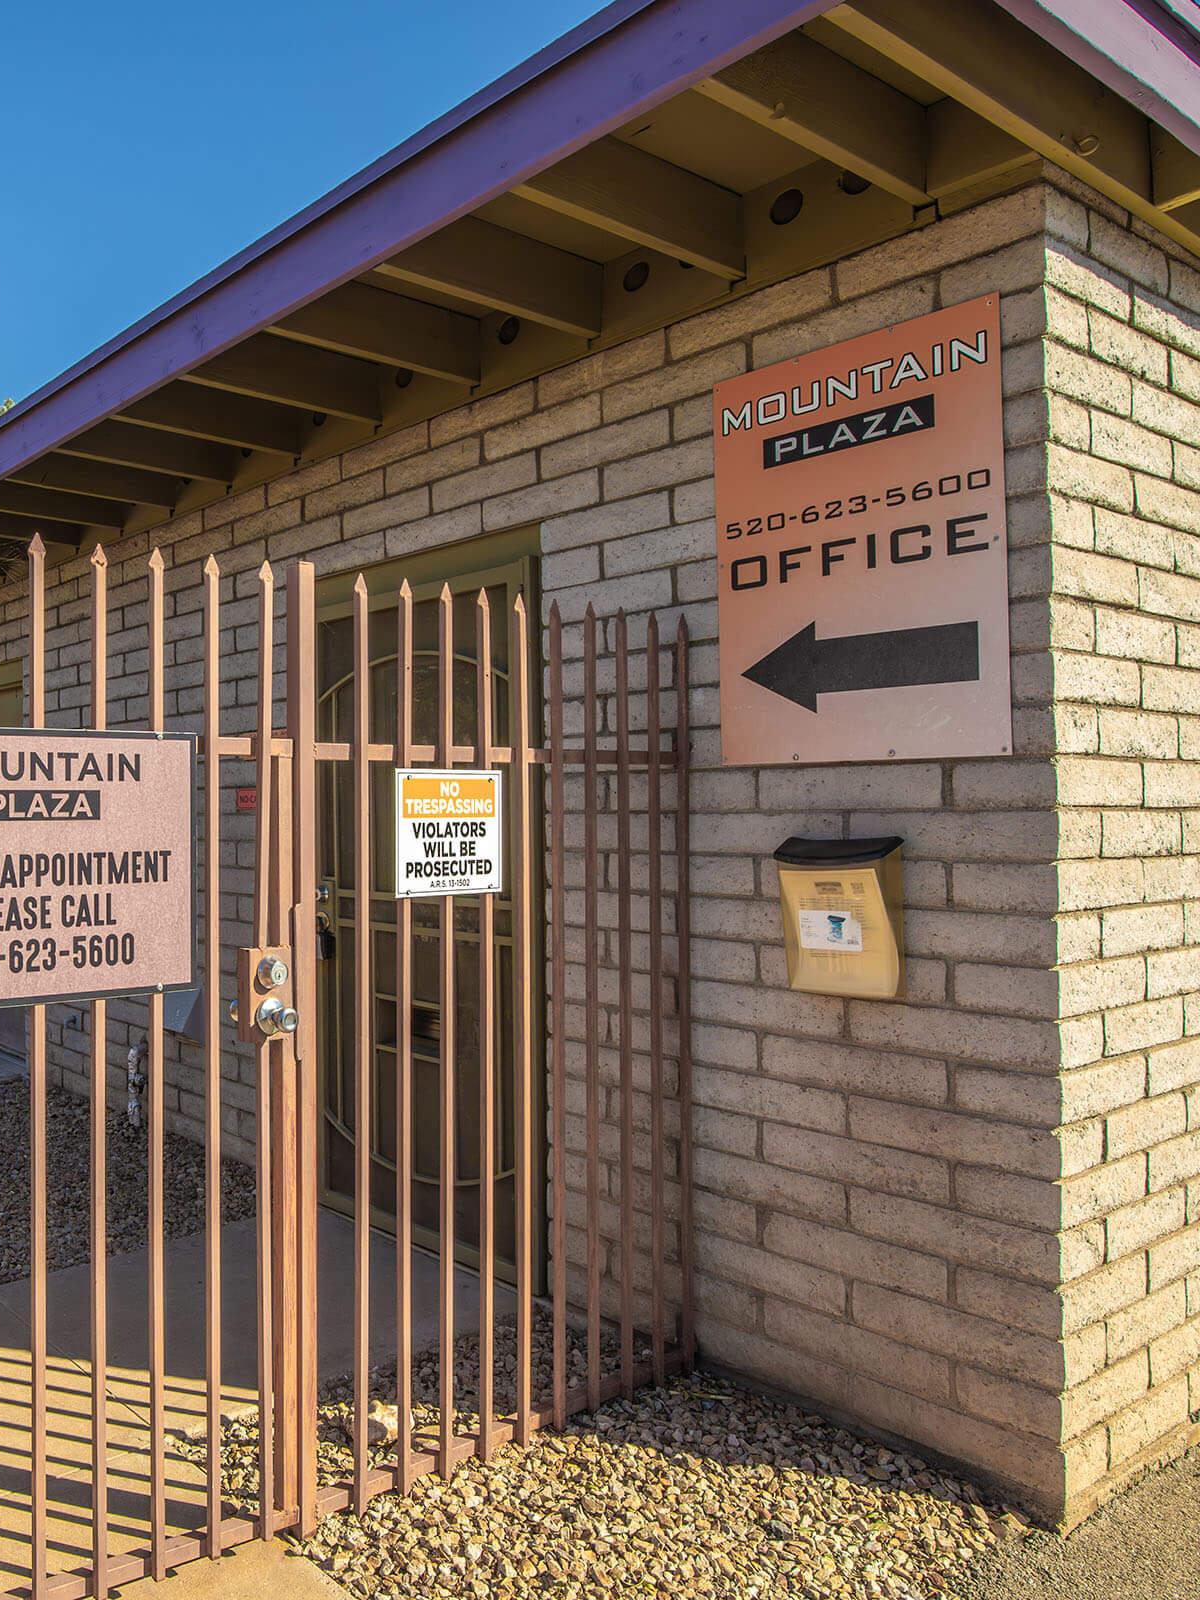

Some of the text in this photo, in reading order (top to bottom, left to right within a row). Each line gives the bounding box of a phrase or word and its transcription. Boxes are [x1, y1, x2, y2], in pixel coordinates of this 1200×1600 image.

[722, 329, 987, 436] MOUNTAIN
[775, 405, 924, 462] PLAZA
[726, 468, 991, 540] 520-623-5600
[730, 513, 990, 591] OFFICE
[405, 798, 493, 815] TRESPASSING
[439, 781, 460, 797] NO
[412, 821, 487, 839] VIOLATORS
[423, 840, 477, 858] WILL BE
[0, 850, 172, 889] APPOINTMENT
[405, 859, 493, 879] PROSECUTED
[61, 893, 117, 928] CALL
